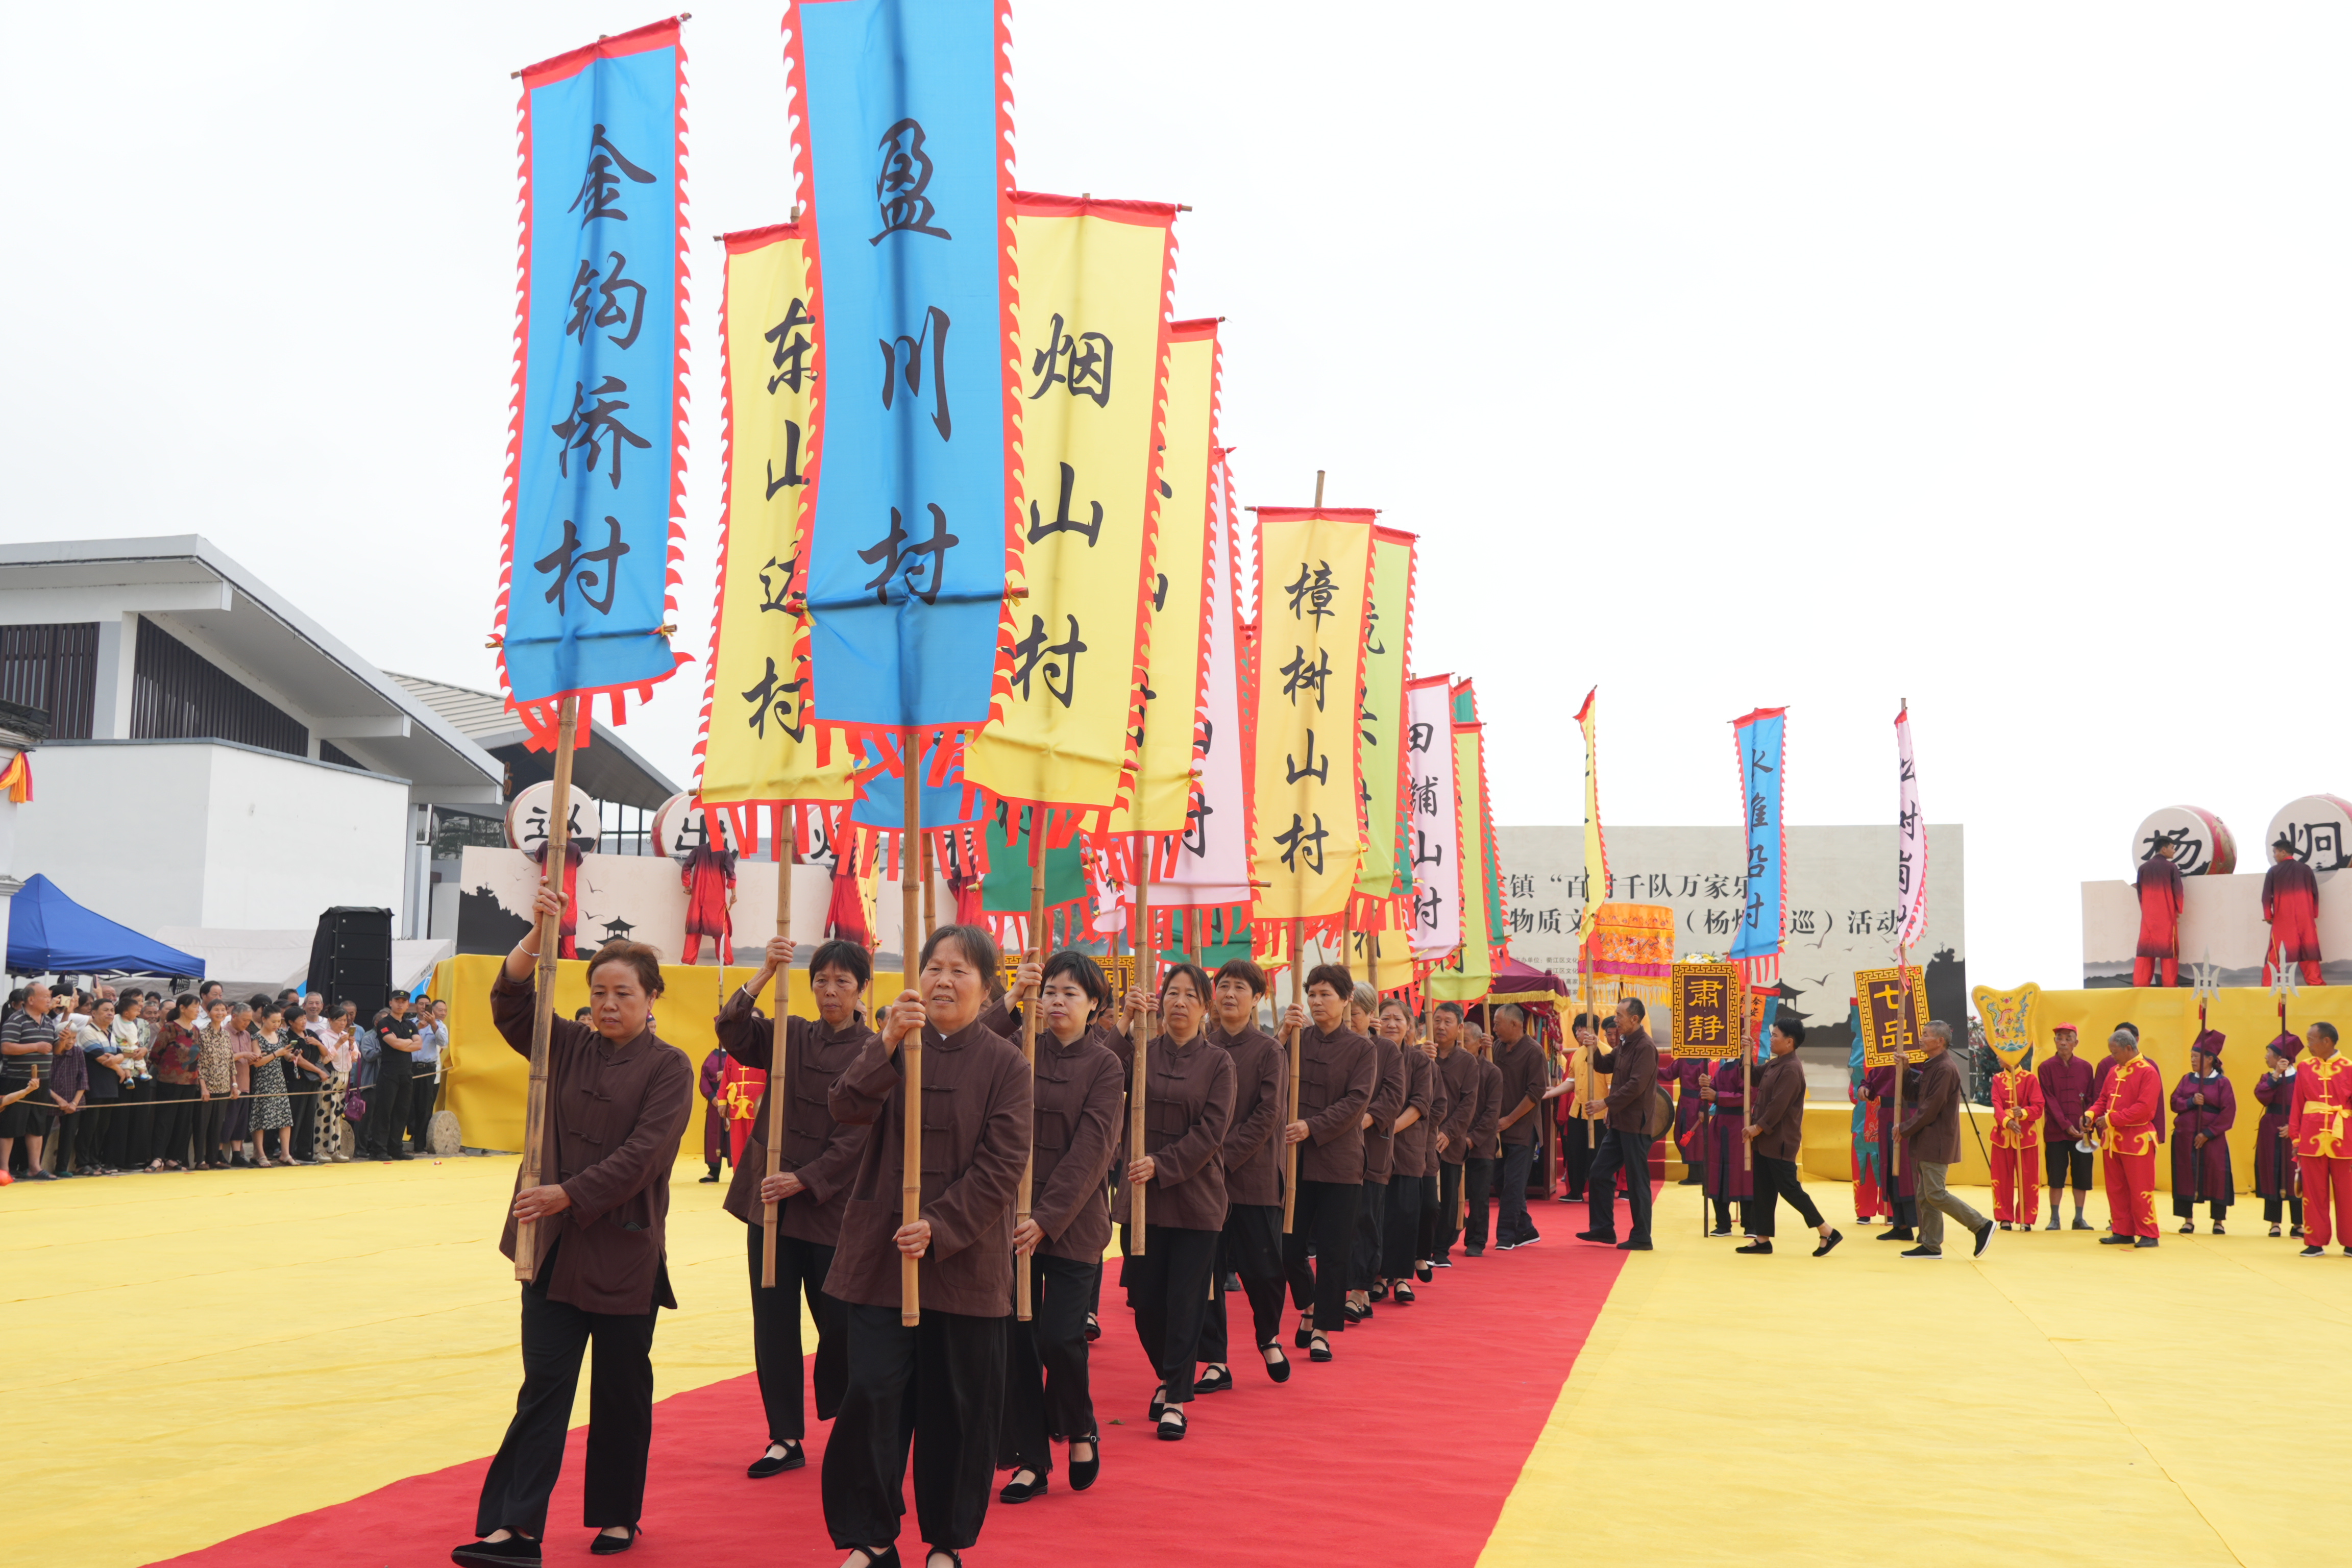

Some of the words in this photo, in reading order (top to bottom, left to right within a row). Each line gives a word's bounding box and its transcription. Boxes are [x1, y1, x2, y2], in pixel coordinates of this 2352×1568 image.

[534, 123, 657, 617] 金钩桥村
[856, 118, 959, 606] 盈川村
[1006, 312, 1114, 709] 烟山村
[1273, 559, 1340, 876] 樟树山村
